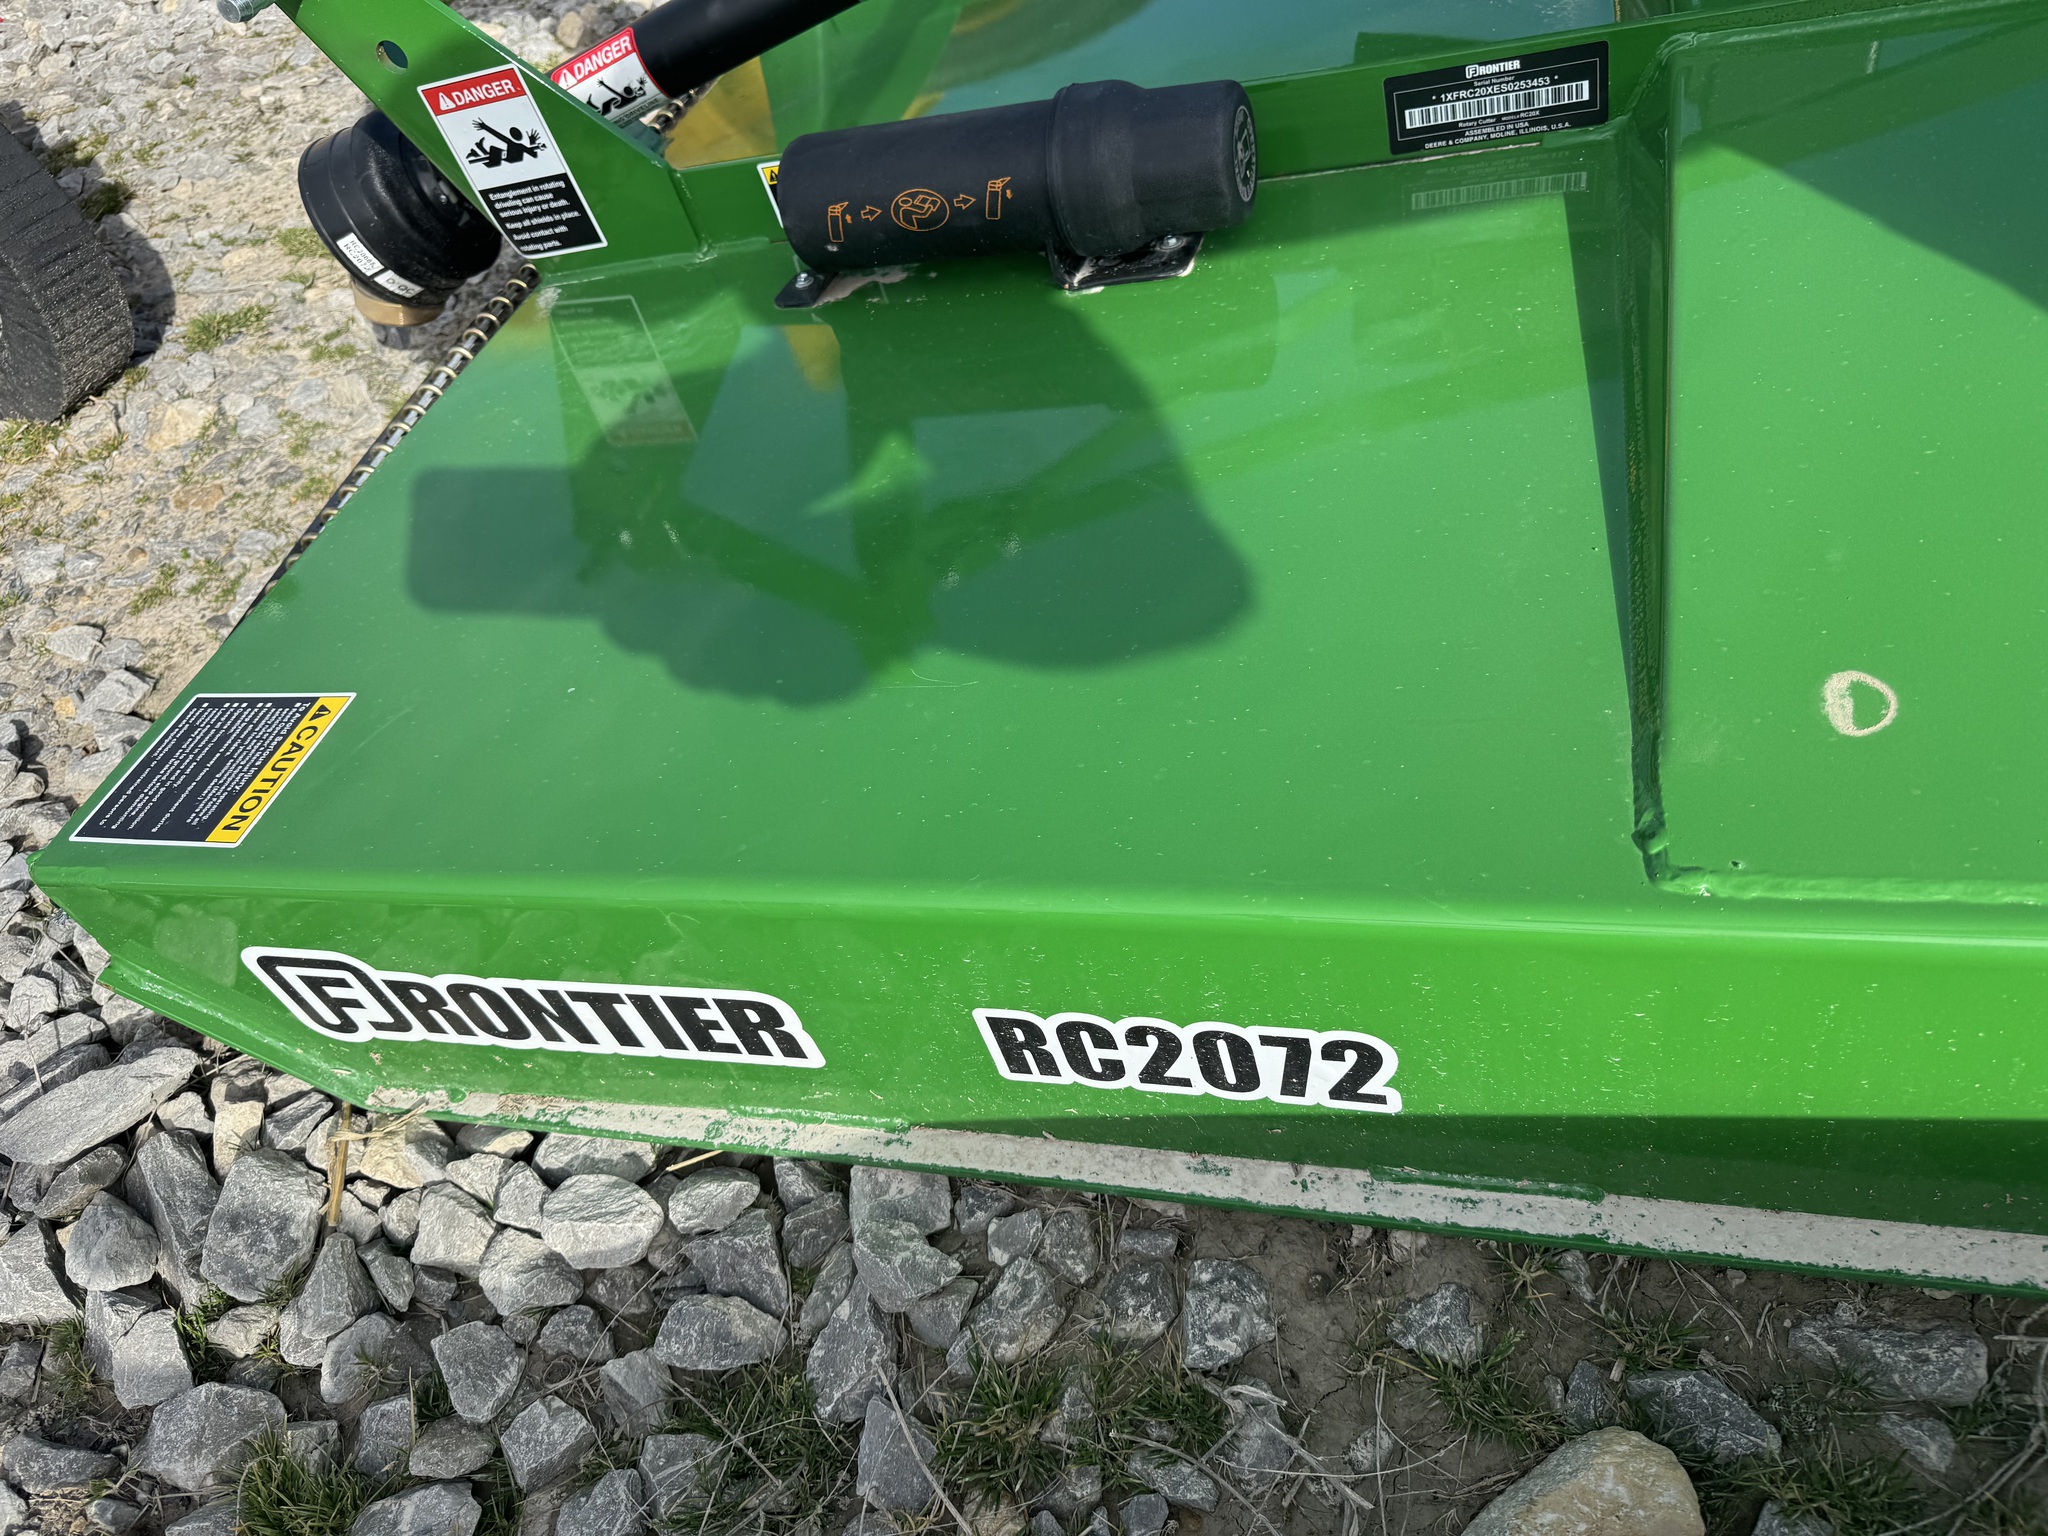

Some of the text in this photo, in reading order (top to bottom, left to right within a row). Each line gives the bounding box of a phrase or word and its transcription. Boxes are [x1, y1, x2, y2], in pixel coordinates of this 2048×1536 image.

[573, 35, 632, 80] DANGER
[1465, 60, 1520, 79] FRONTIER
[452, 80, 515, 106] DANGER
[1441, 77, 1550, 102] 1XFRC20XES0253453
[1465, 125, 1505, 136] ASSEMBLED
[1425, 141, 1446, 149] DEERE
[489, 187, 532, 200] Entanglement
[539, 181, 565, 190] rotating
[534, 193, 553, 201] cause
[499, 209, 523, 218] serious
[522, 205, 541, 214] injury
[549, 199, 570, 208] death.
[531, 215, 554, 225] shields
[530, 228, 554, 238] contact
[554, 225, 568, 233] with
[233, 702, 311, 792] To Avoid Serious Injury:
[222, 726, 318, 831] CAUTION
[256, 955, 808, 1060] FRONTIER
[985, 1016, 1388, 1105] RC2072
